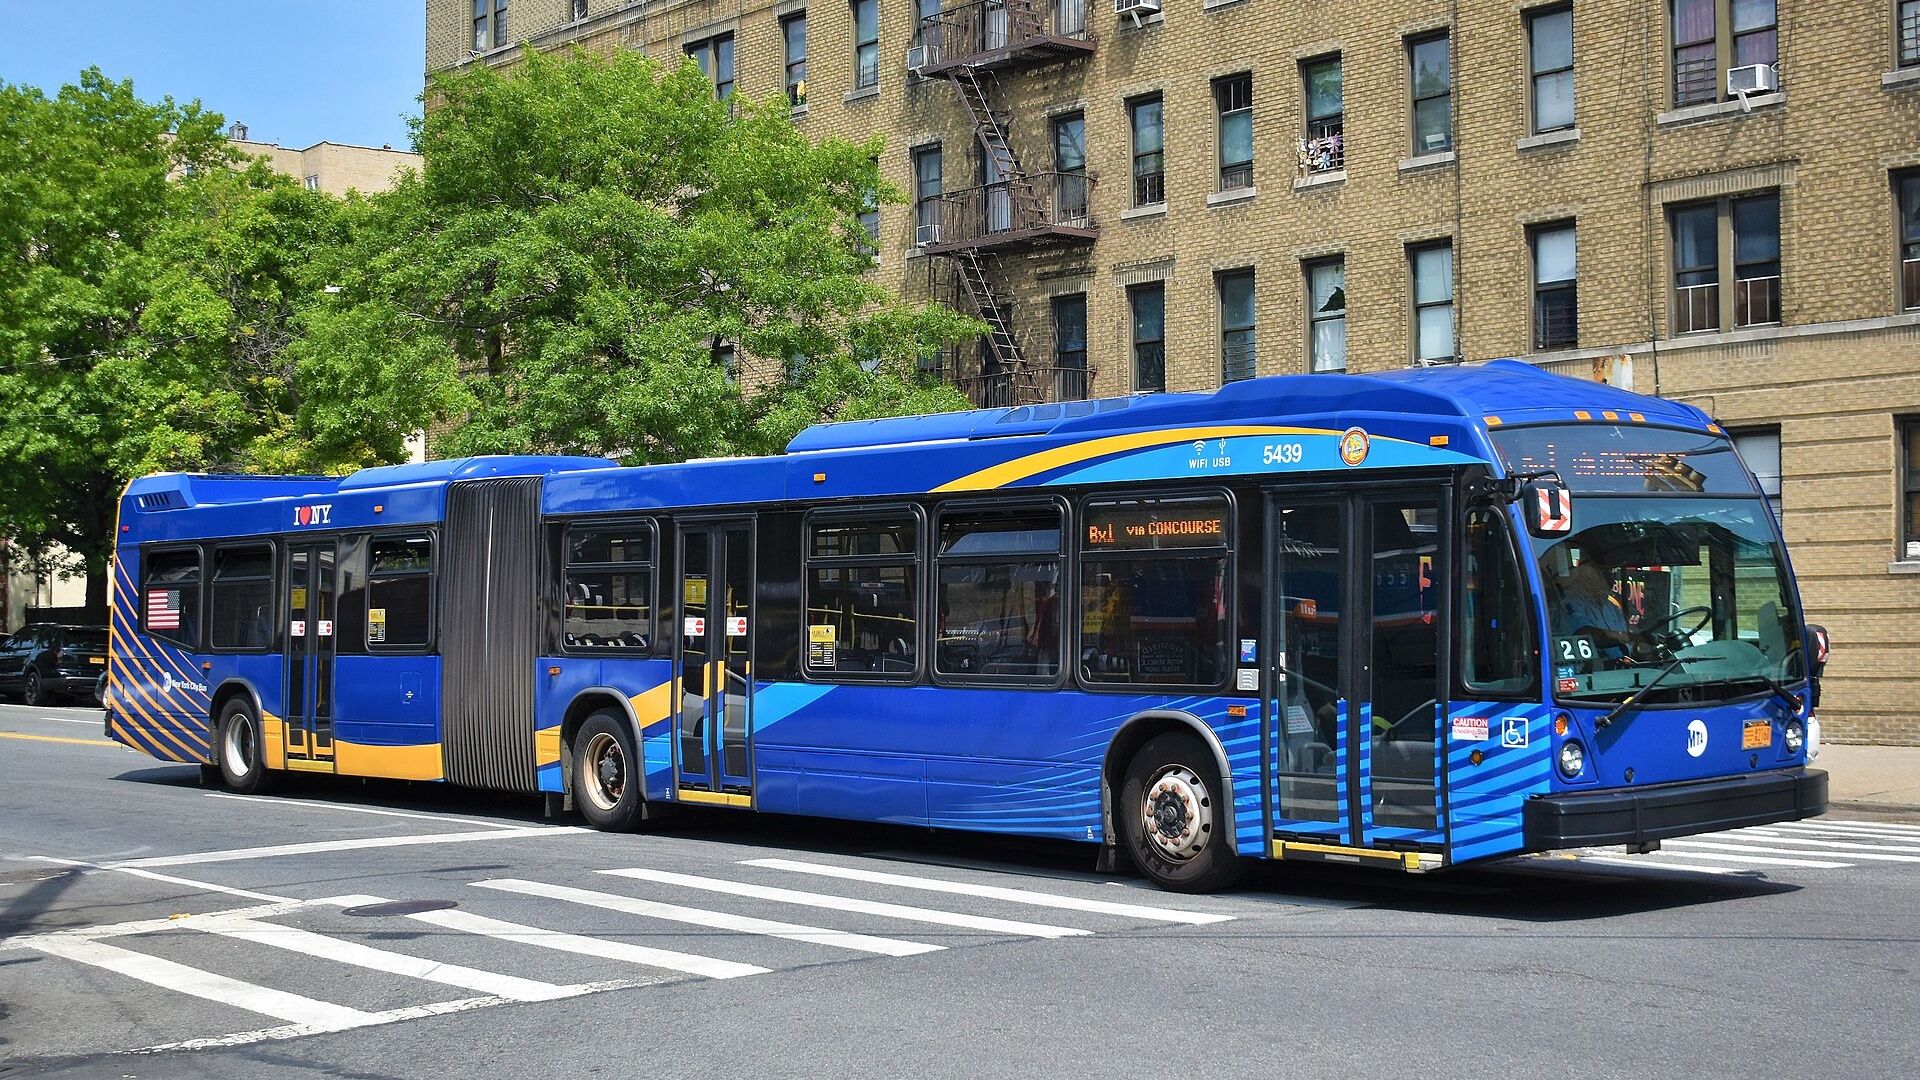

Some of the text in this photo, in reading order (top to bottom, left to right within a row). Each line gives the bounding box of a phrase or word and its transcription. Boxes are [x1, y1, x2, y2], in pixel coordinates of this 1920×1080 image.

[1189, 457, 1231, 468] WIFI USB
[1263, 443, 1302, 465] 5439
[293, 506, 301, 526] I
[1126, 526, 1145, 536] VIA
[1148, 519, 1221, 535] CONCOURSE
[1453, 717, 1488, 728] CAUTION
